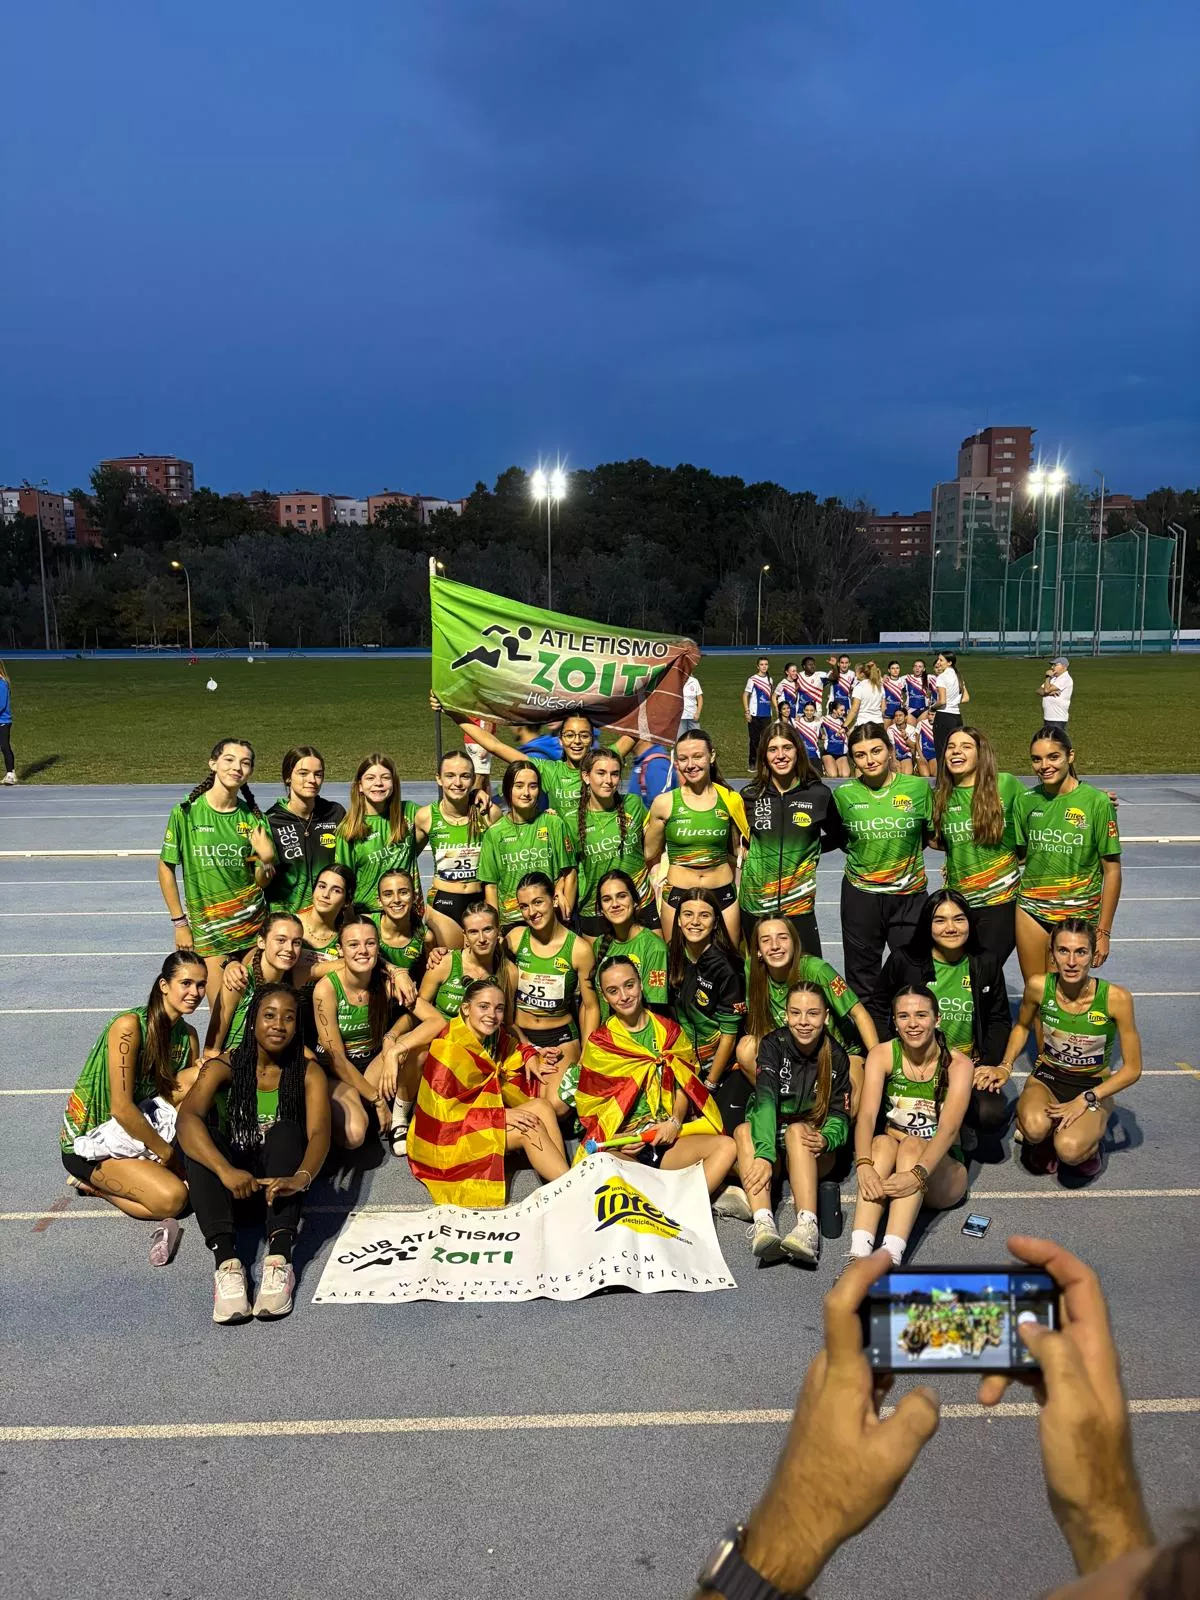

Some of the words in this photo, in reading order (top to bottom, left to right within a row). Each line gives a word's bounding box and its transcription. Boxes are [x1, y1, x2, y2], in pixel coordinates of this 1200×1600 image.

[539, 629, 669, 658] ATLETISMO
[526, 692, 585, 710] HUESCA
[676, 827, 728, 837] Huesca
[849, 816, 915, 832] Huesca
[454, 859, 472, 870] 25
[528, 984, 546, 998] 25
[1061, 1043, 1083, 1058] 25
[907, 1111, 927, 1127] 25
[479, 1180, 572, 1220] ATLETISMO
[337, 1239, 393, 1265] CLUB
[400, 1224, 521, 1245] ATLETISMO
[430, 1246, 514, 1265] ZOITI
[328, 1290, 376, 1298] AIRE
[388, 1283, 560, 1298] ACONDICIONADO
[589, 1264, 727, 1285] ELECTRICIDAD
